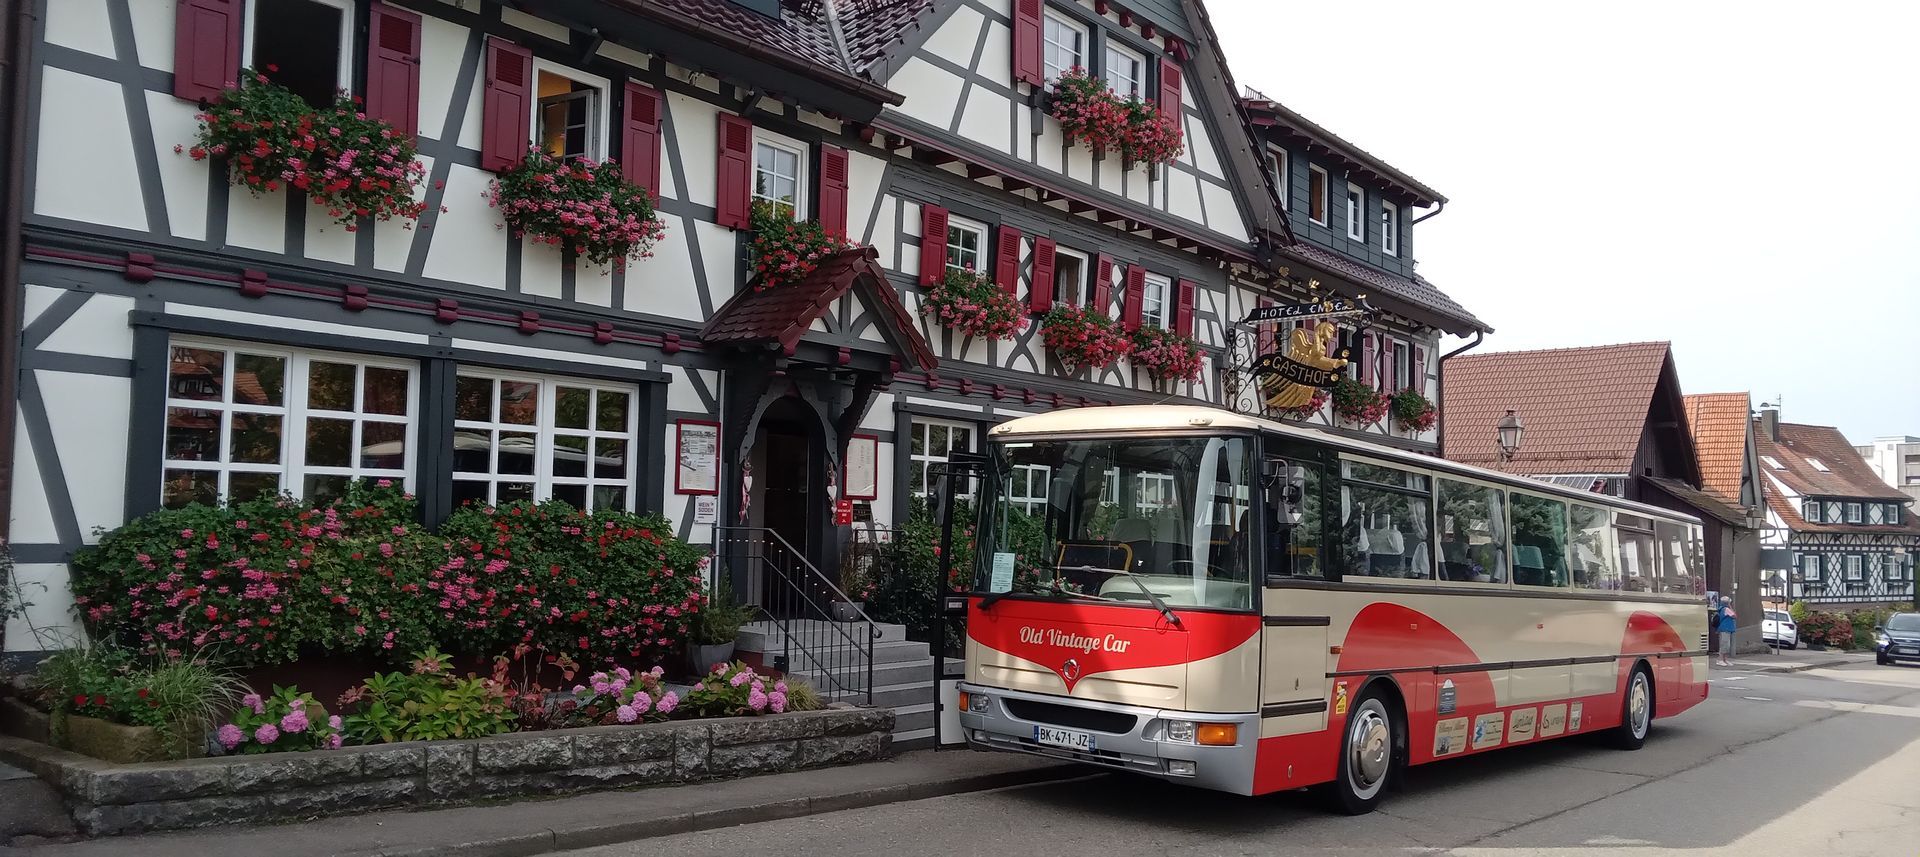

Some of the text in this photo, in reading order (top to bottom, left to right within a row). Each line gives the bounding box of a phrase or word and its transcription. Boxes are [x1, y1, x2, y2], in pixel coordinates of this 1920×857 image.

[1272, 356, 1331, 385] GASTHOF
[1020, 626, 1131, 654] Old Vintage Car
[1040, 728, 1088, 747] BK-471-JZ
